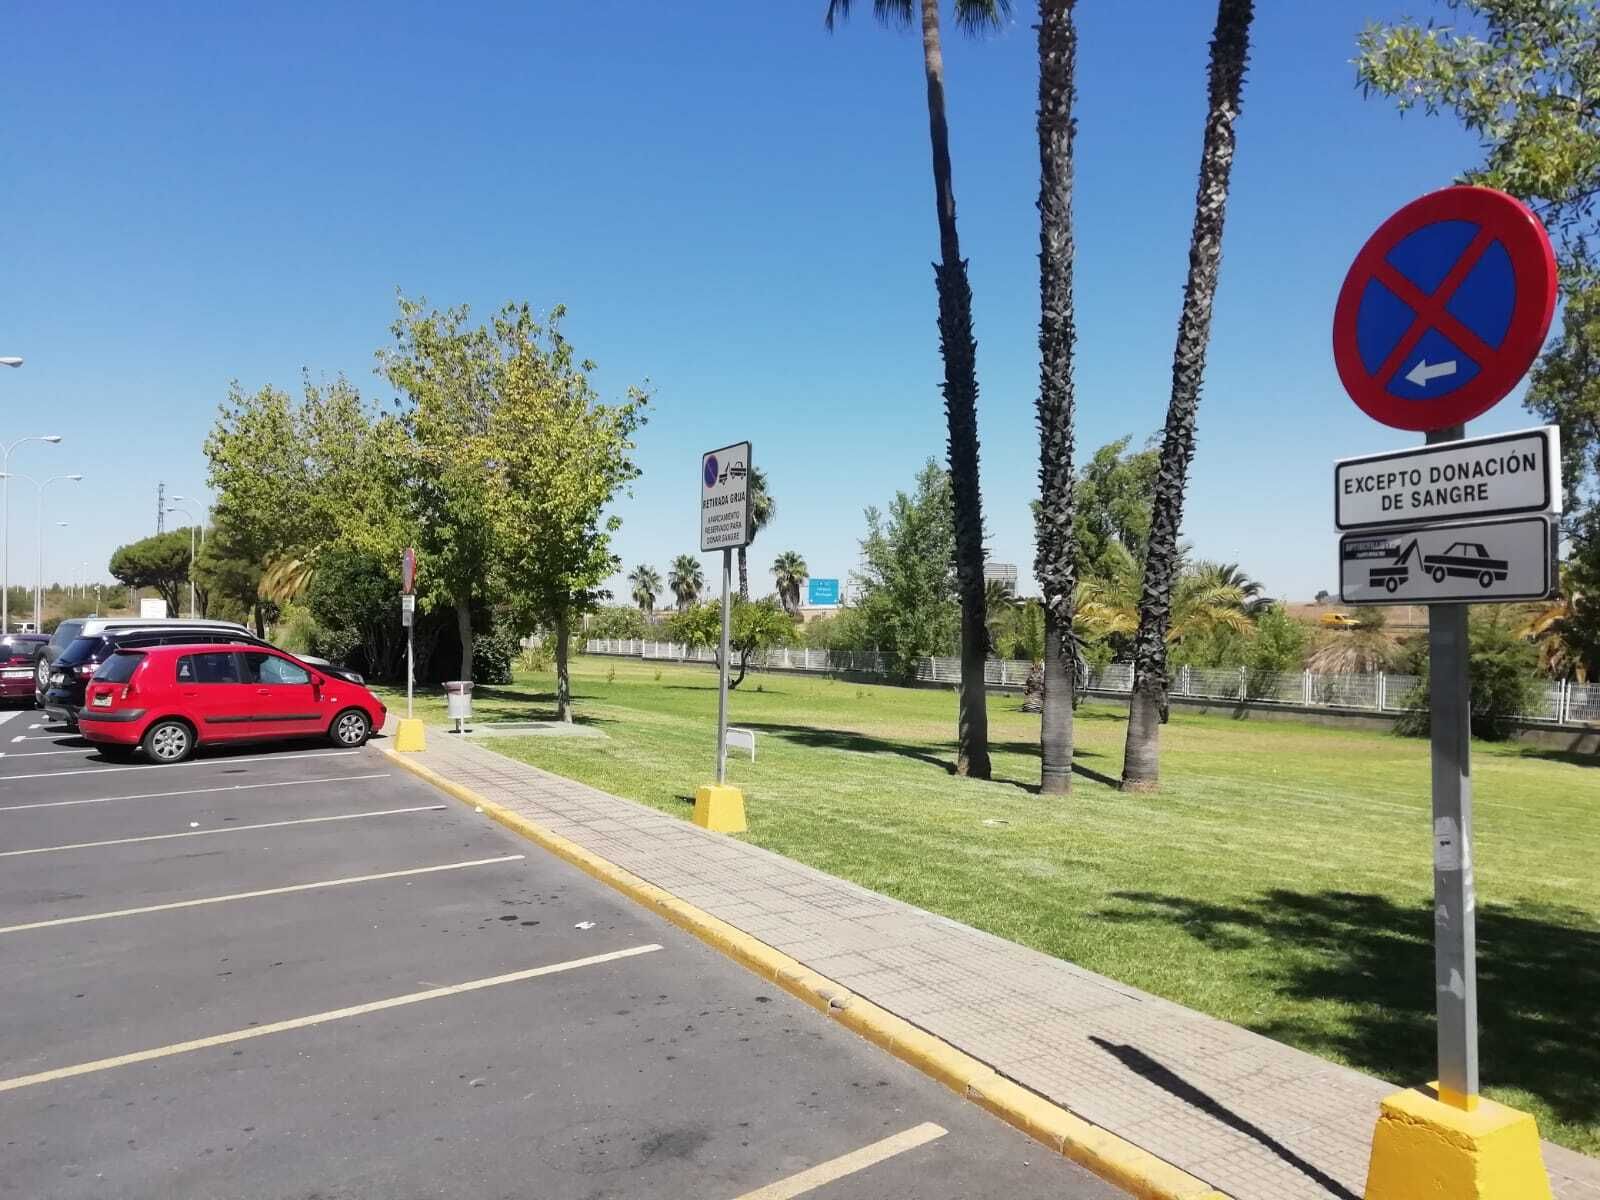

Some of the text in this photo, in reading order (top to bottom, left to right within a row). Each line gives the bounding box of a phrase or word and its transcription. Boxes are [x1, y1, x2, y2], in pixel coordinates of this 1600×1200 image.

[1344, 450, 1536, 495] EXCEPTO DONACIÓN
[704, 495, 728, 508] RETIRADA
[1382, 483, 1489, 511] DE SANGRE
